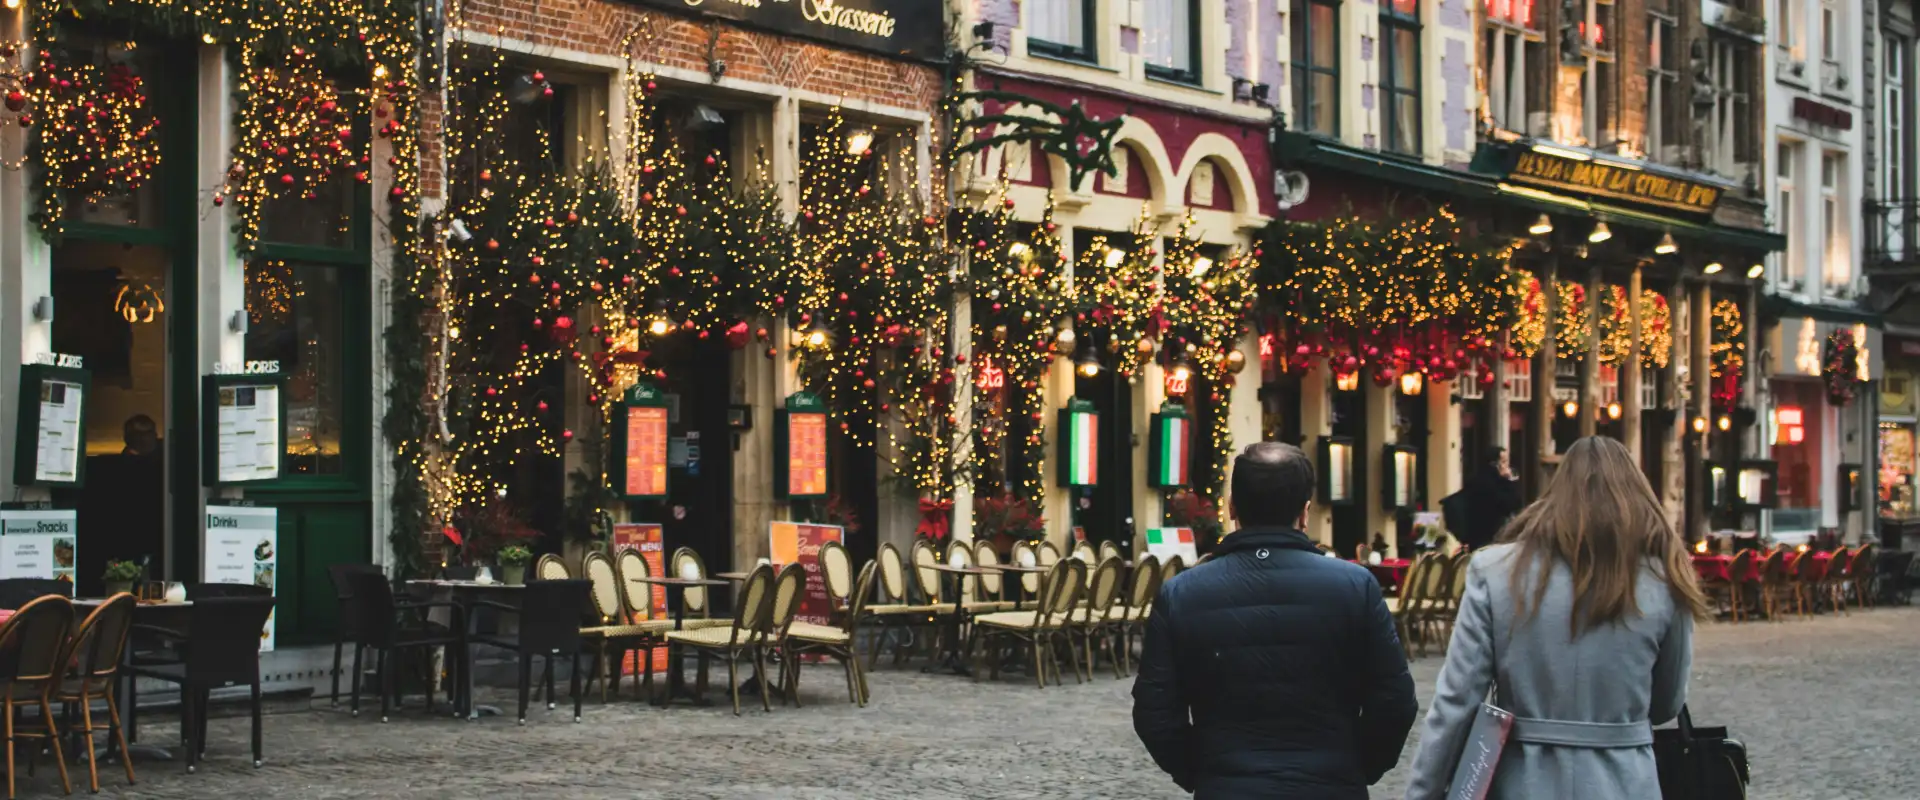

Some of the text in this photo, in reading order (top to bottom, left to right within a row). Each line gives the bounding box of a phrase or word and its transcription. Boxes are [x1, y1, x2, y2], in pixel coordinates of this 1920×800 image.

[801, 0, 896, 38] Brasserie
[245, 360, 280, 374] JORIS
[37, 520, 69, 533] Snacks
[212, 516, 238, 528] Drinks
